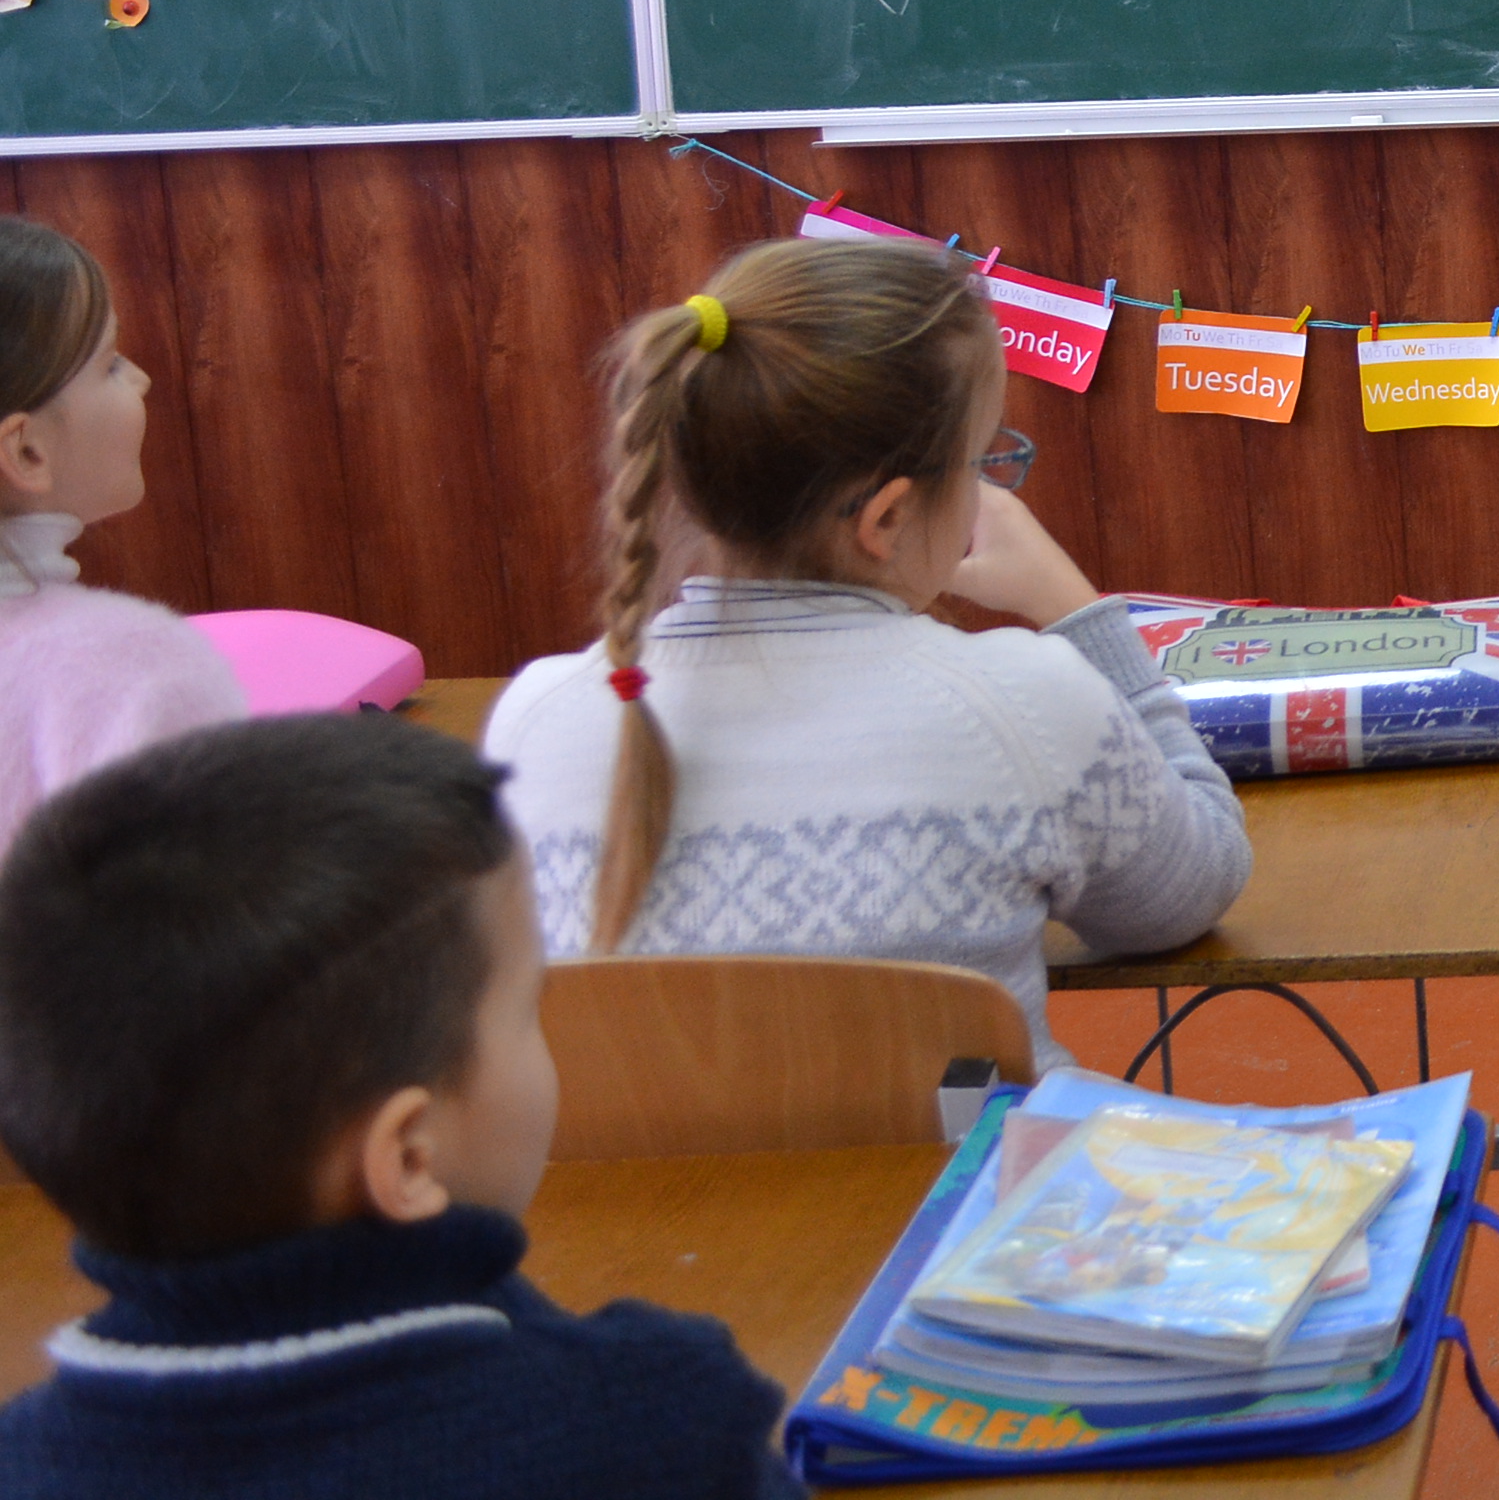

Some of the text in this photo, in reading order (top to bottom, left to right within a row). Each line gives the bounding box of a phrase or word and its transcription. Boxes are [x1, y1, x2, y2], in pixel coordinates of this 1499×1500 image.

[1184, 329, 1201, 341] Tu
[1000, 326, 1092, 375] onday
[1402, 344, 1426, 356] We
[1165, 363, 1294, 408] Tuesday
[1279, 632, 1446, 657] London
